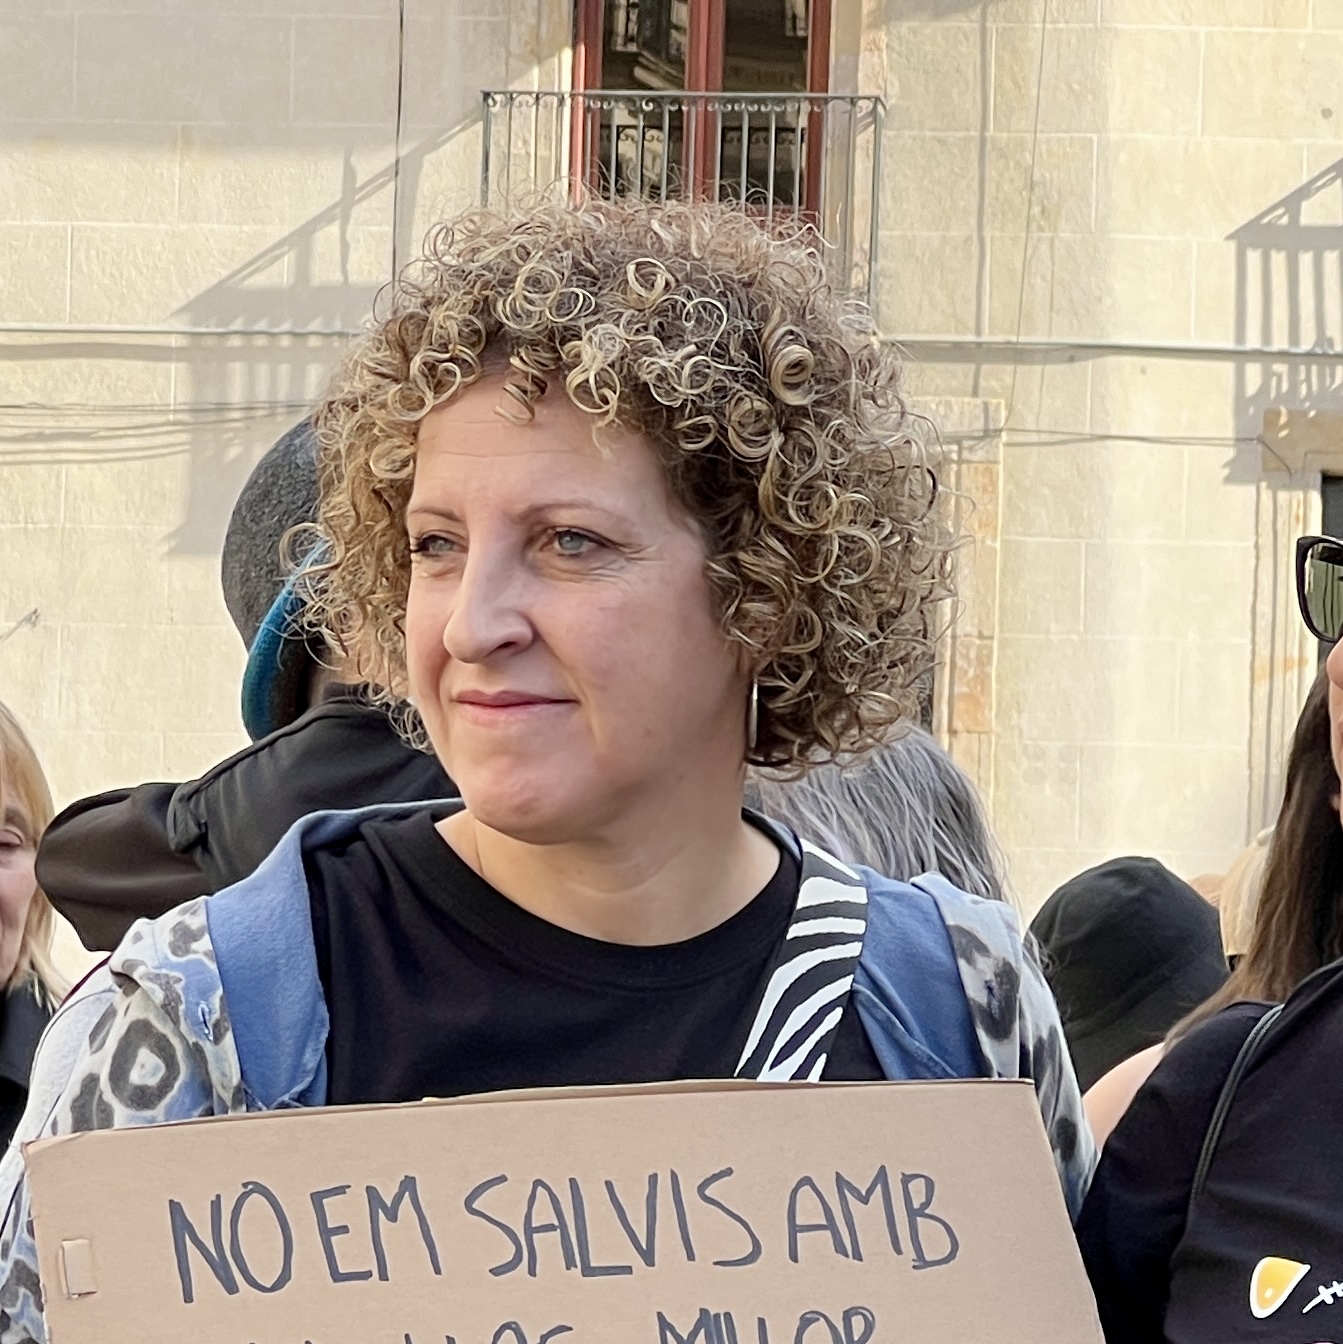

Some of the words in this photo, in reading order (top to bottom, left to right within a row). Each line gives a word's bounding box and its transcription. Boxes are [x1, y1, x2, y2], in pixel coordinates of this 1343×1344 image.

[168, 1181, 293, 1304] NO
[323, 1175, 442, 1283] EM
[464, 1167, 762, 1278] SALVIS
[787, 1164, 959, 1270] AMB
